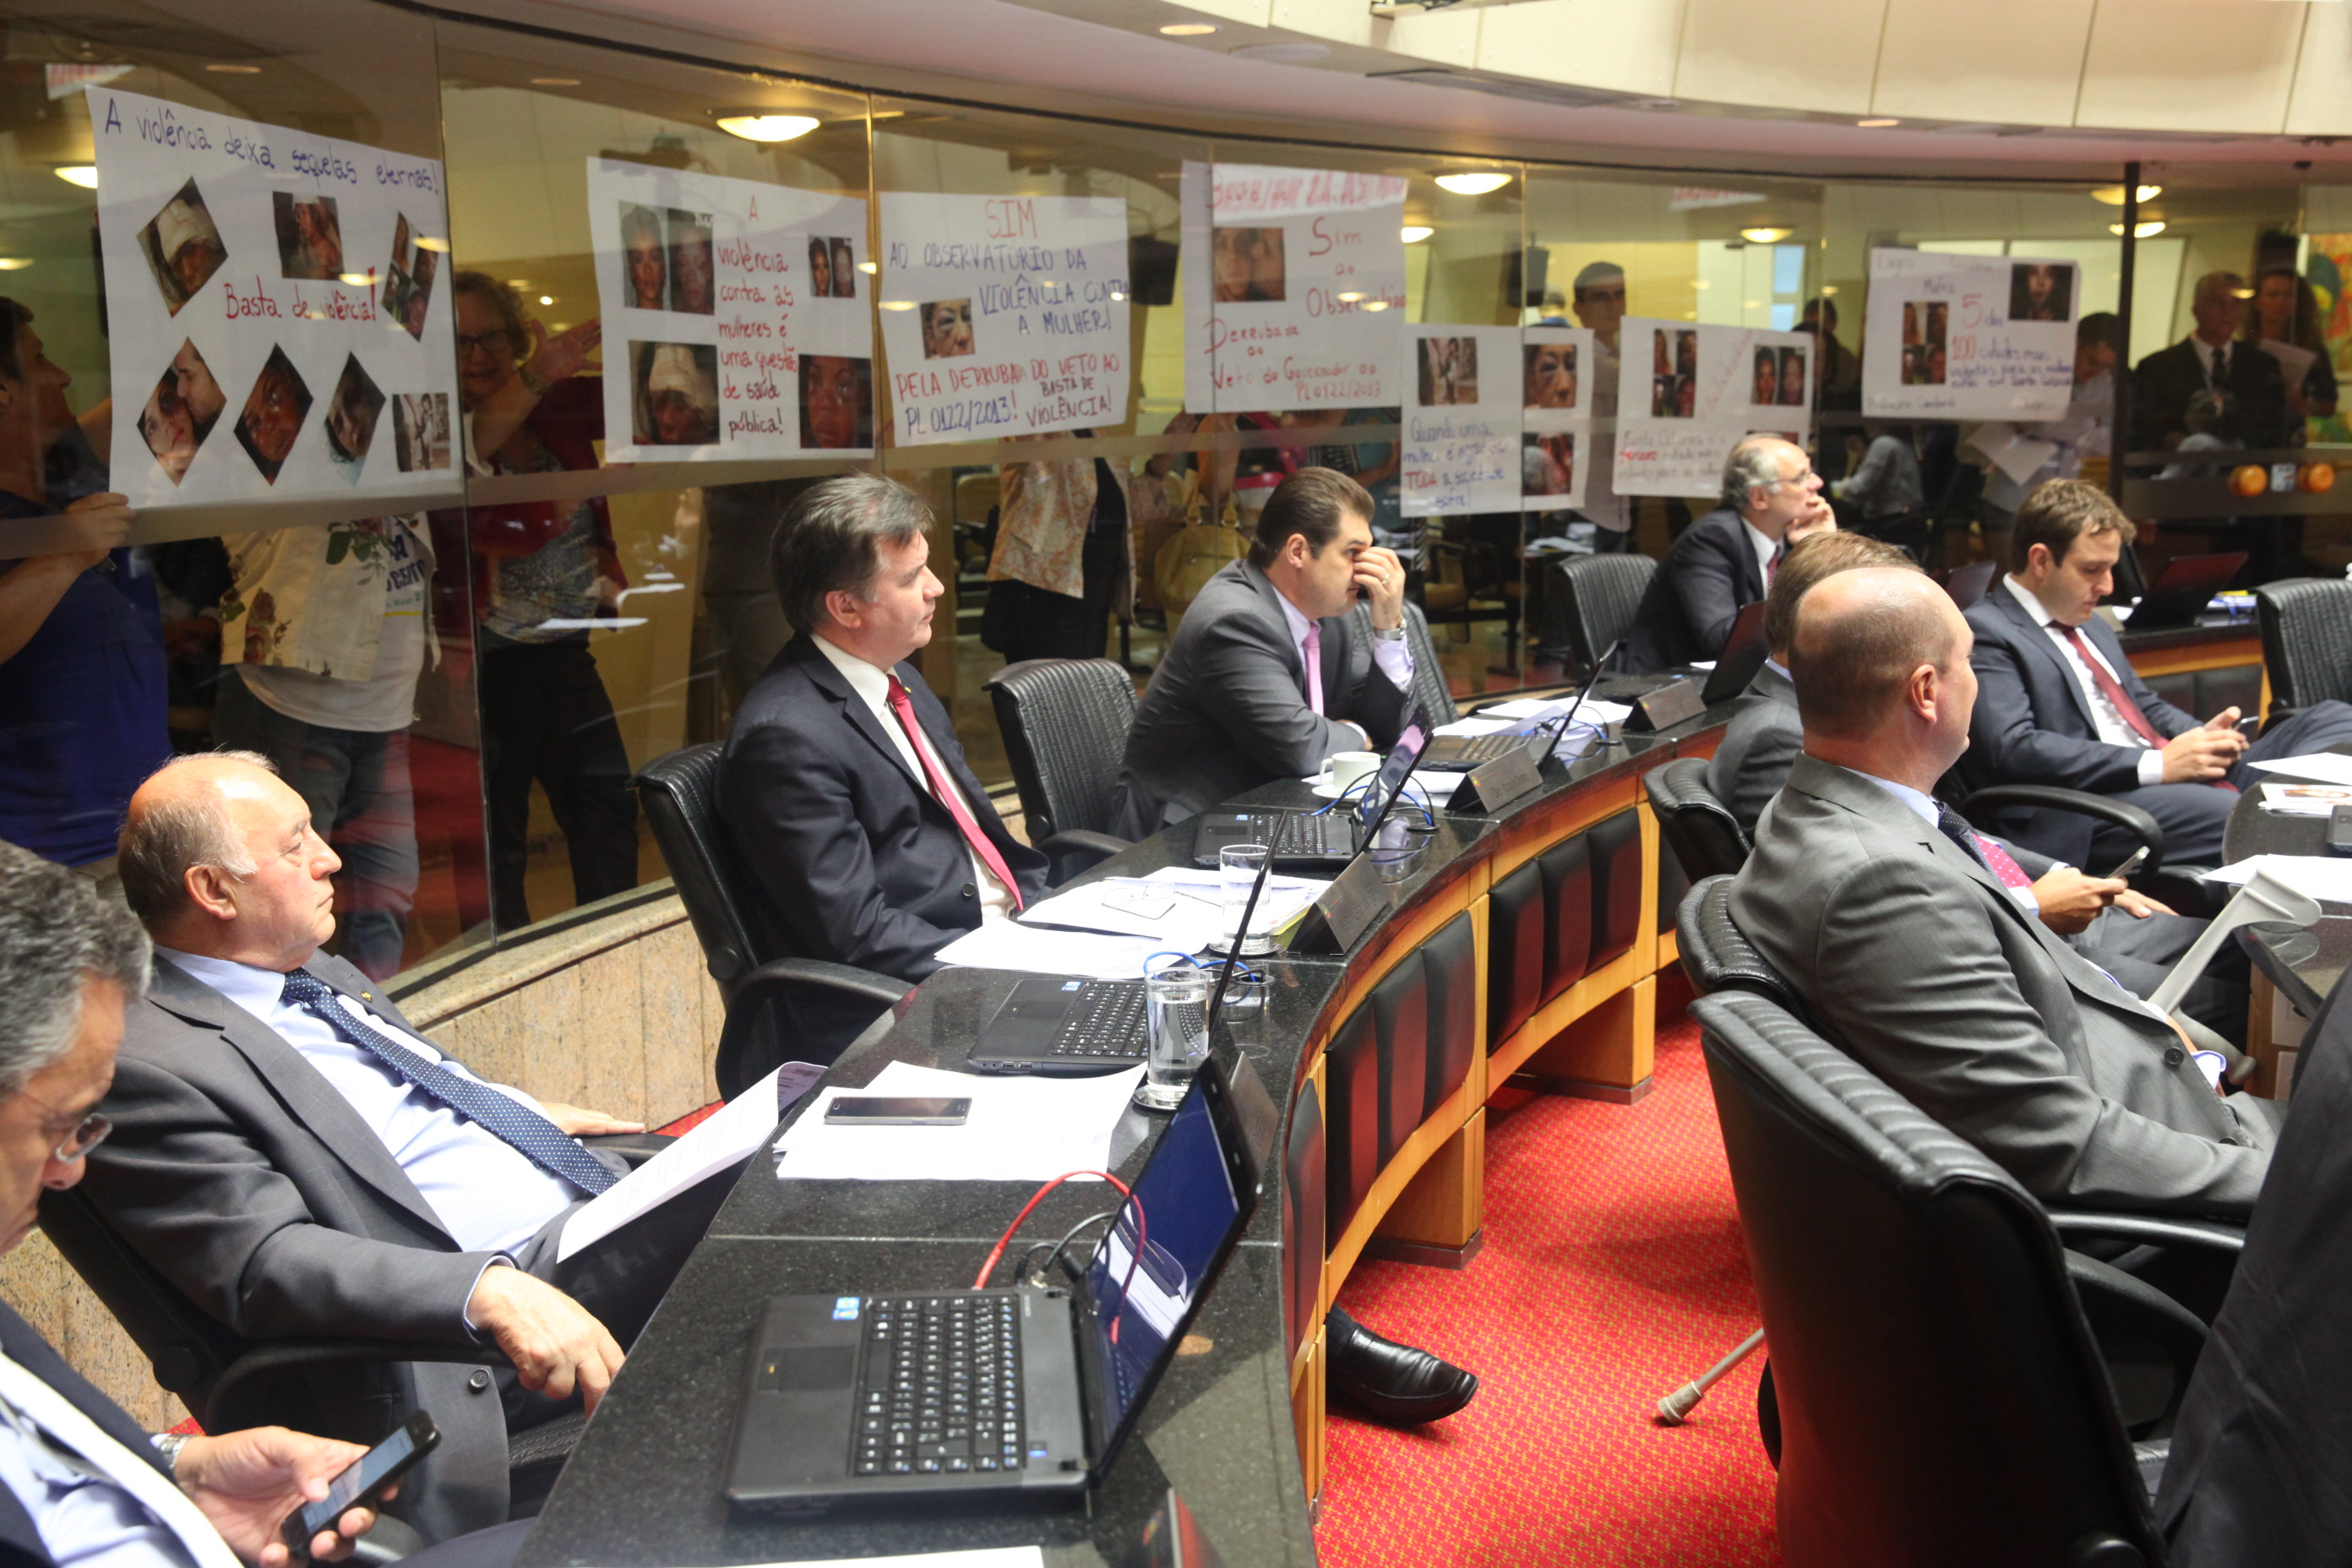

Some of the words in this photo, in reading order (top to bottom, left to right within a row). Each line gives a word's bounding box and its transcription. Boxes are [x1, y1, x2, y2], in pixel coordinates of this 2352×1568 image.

[105, 97, 122, 133] A
[136, 106, 211, 150] violência
[224, 126, 275, 169] deixa
[749, 194, 760, 220] A
[985, 199, 1037, 239] SIM
[1309, 216, 1363, 257] Sim
[717, 237, 788, 272] violência
[890, 242, 908, 270] AO
[1065, 248, 1086, 270] DA
[224, 275, 282, 319] Basta
[292, 283, 313, 319] de
[721, 277, 765, 302] contra
[774, 285, 793, 306] as
[979, 274, 1075, 316] VIOLÊNCIA
[719, 313, 772, 340] mulheres
[780, 313, 788, 337] é
[1018, 314, 1030, 335] A
[1043, 303, 1111, 335] MULHER!
[1962, 293, 1984, 329] 5
[721, 351, 753, 368] uma
[724, 374, 741, 399] de
[896, 372, 942, 402] PELA
[1030, 358, 1048, 380] DO
[1058, 352, 1097, 376] VETO
[1103, 352, 1119, 373] AO
[1040, 377, 1077, 397] BASTA
[1081, 376, 1094, 391] DE
[729, 406, 783, 441] pública!
[905, 406, 927, 437] PL
